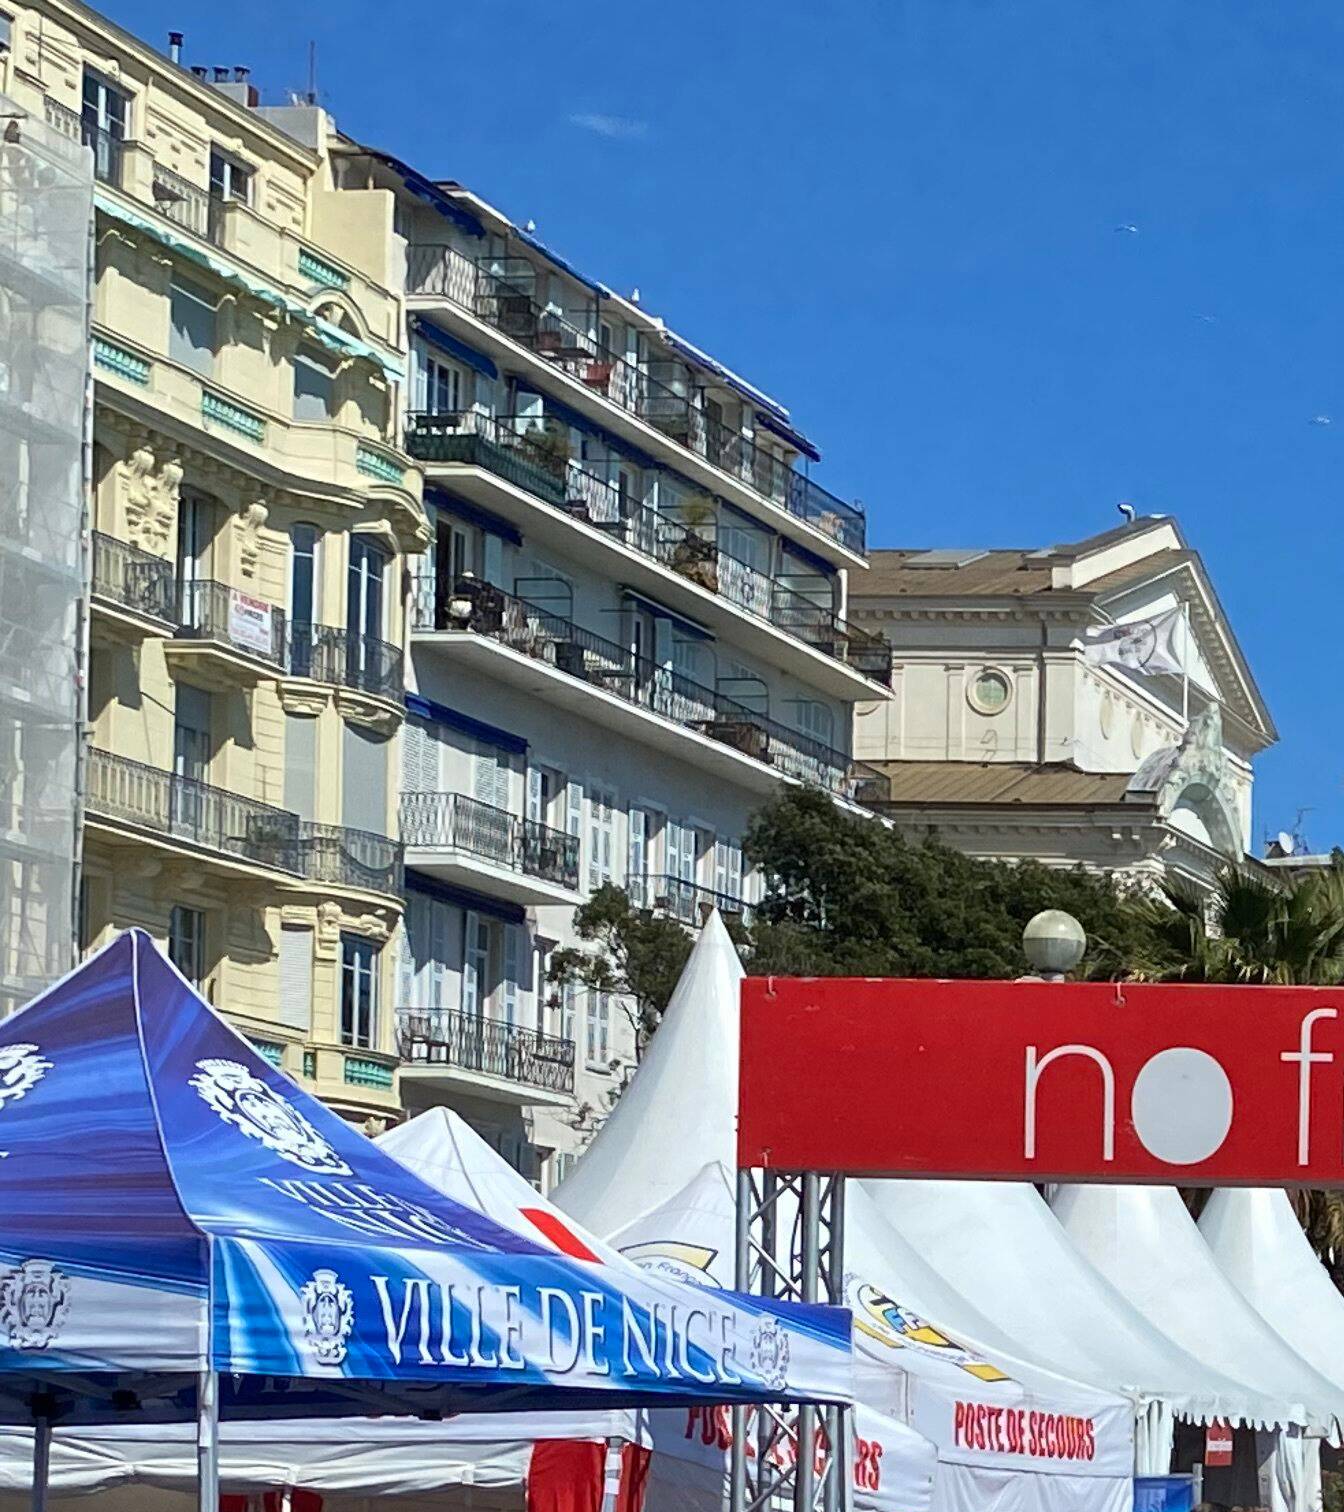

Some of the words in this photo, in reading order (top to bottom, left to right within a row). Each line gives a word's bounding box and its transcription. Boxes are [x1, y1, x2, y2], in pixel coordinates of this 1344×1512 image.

[1024, 1044, 1233, 1165] no
[255, 1176, 404, 1212] VILLE
[369, 1275, 526, 1370] VILLE
[534, 1286, 610, 1376] DE
[621, 1296, 743, 1386] NICE
[954, 1400, 1005, 1453] POSTE
[1006, 1408, 1025, 1455] DE
[1028, 1410, 1096, 1462] SECOURS
